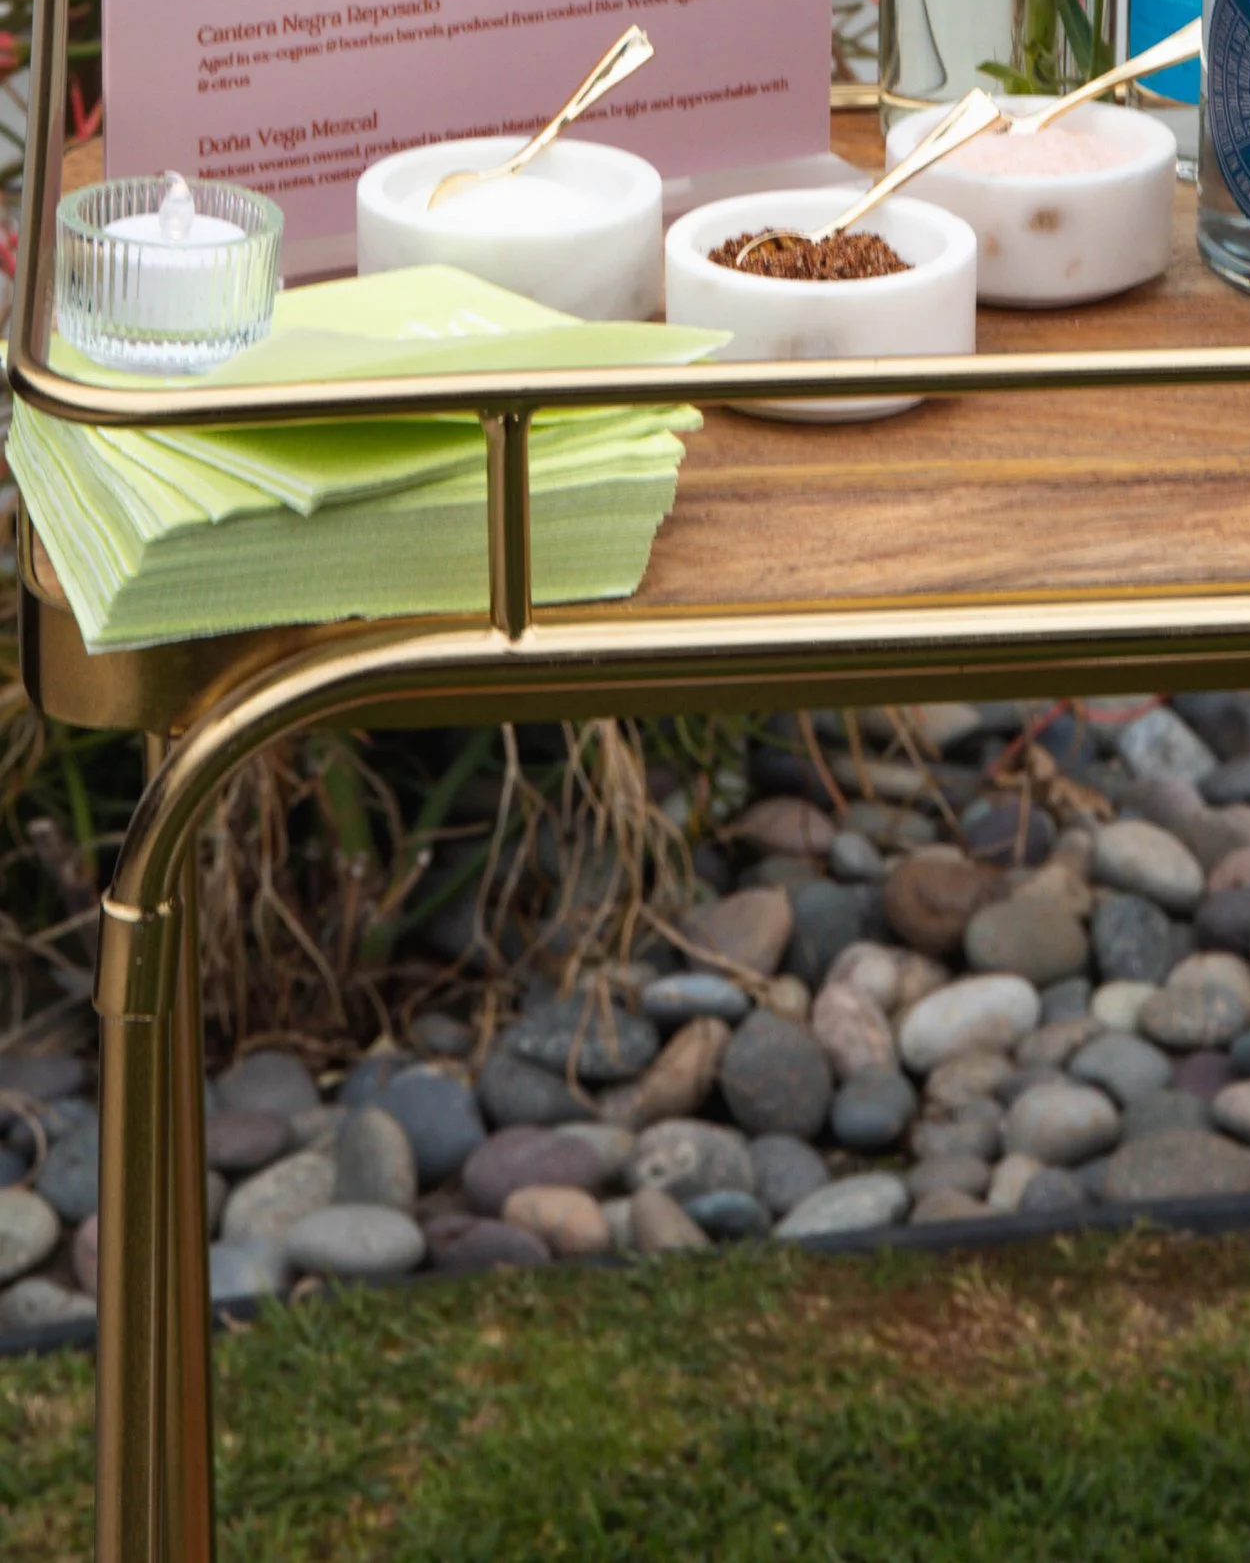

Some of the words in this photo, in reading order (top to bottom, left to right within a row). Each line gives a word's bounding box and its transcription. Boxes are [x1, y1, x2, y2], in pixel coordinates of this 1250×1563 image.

[196, 21, 277, 46] Cantera
[282, 13, 342, 36] Negra
[198, 50, 234, 71] Aged
[237, 49, 250, 63] in
[340, 30, 394, 49] bourbon
[448, 12, 509, 37] produced
[512, 10, 544, 25] from
[547, 0, 592, 20] cooked
[211, 75, 250, 91] citrus
[199, 133, 251, 156] Doña
[257, 128, 307, 149] Vega
[311, 111, 378, 139] Mezcal
[258, 152, 310, 169] women
